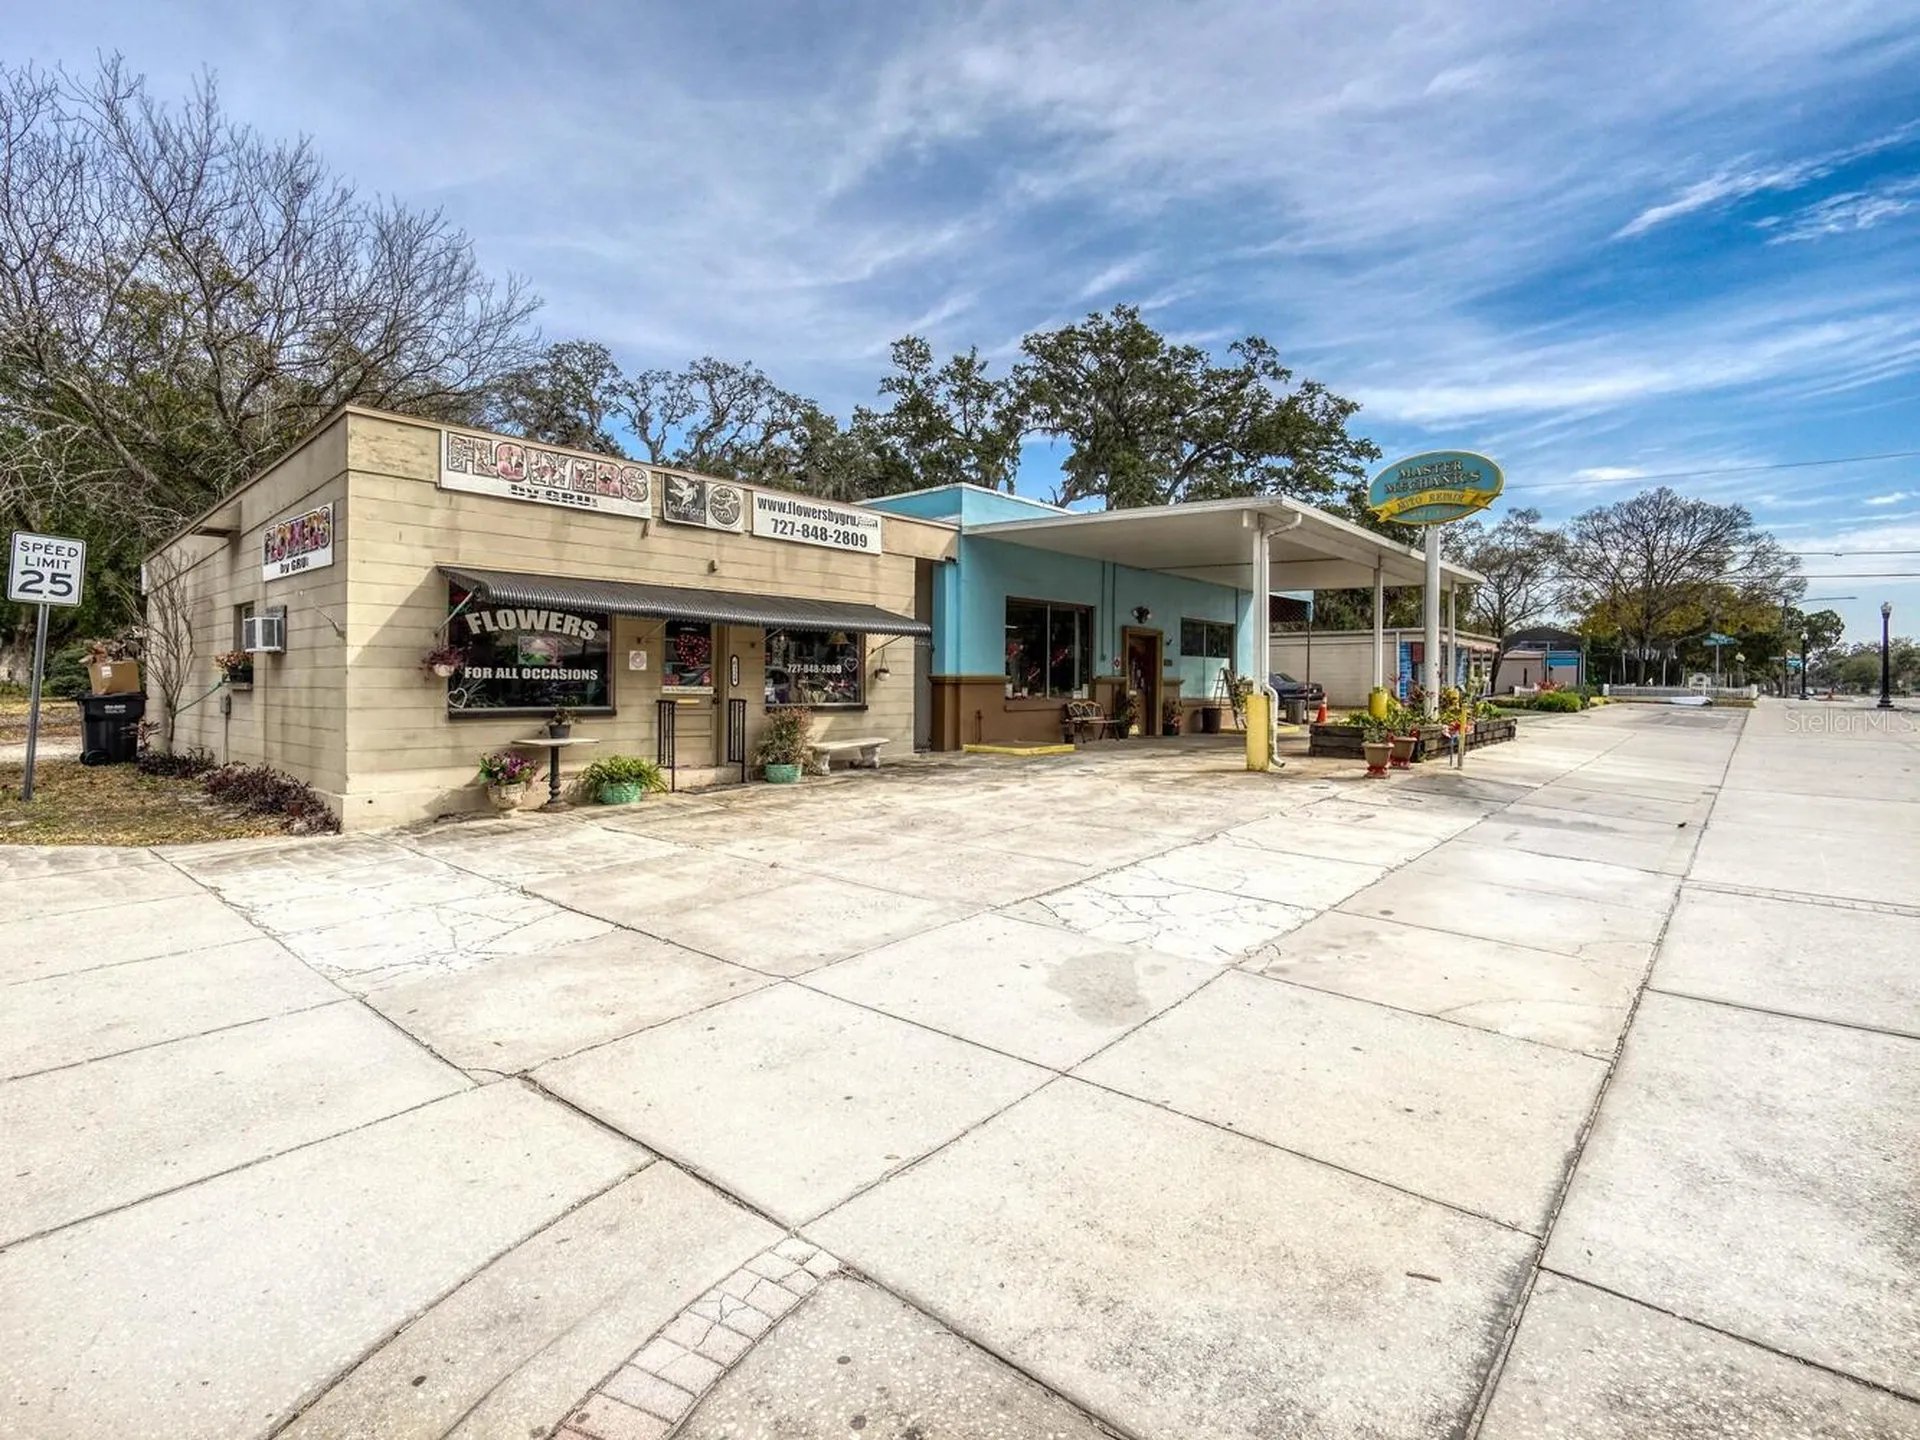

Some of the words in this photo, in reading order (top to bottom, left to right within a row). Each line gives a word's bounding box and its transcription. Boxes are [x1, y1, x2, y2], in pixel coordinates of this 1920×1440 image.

[447, 432, 649, 502] FLOWERS
[1398, 460, 1464, 479] MASTER
[1384, 469, 1481, 494] MECHANICS
[1397, 495, 1422, 509] AUTO
[264, 506, 331, 565] FLOWERS
[771, 518, 868, 548] 727-848-2809
[20, 541, 79, 558] SPEED
[25, 555, 71, 570] LIMIT
[18, 570, 73, 597] 25
[465, 609, 598, 641] FLOWERS
[464, 667, 493, 679] FOR
[495, 667, 519, 680] ALL
[521, 668, 598, 681] OCCASIONS
[787, 663, 842, 674] 727-848-2809
